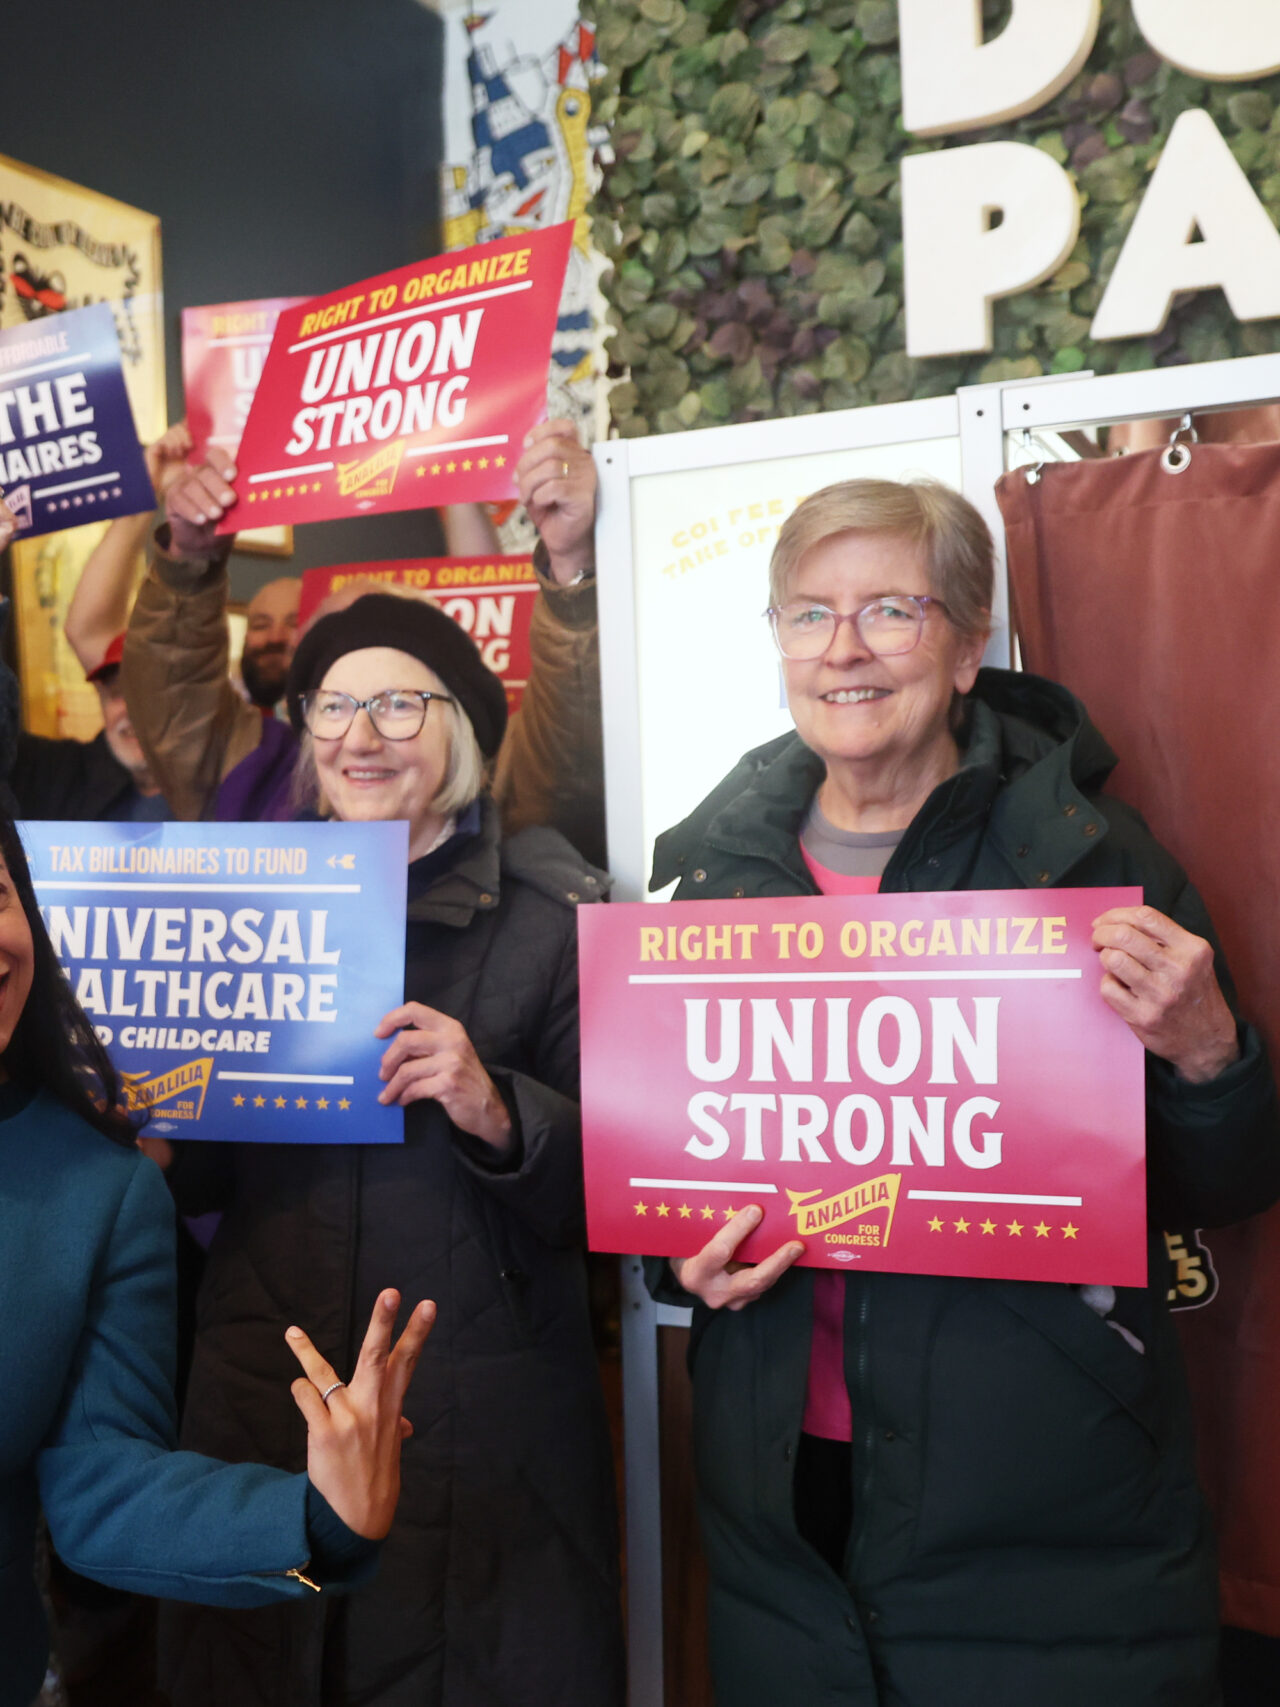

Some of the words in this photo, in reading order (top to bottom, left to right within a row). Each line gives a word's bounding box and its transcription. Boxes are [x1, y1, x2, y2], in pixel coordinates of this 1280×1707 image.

[298, 295, 365, 338] RIGHT
[368, 285, 398, 314] TO
[402, 248, 532, 304] ORGANIZE
[299, 307, 485, 404] UNION
[284, 375, 470, 456] STRONG
[403, 568, 431, 587] TO
[48, 845, 85, 873] TAX
[88, 846, 220, 875] BILLIONAIRES
[224, 847, 248, 875] TO
[253, 847, 308, 876] FUND
[38, 905, 342, 966] NIVERSAL
[639, 924, 759, 961] RIGHT
[771, 921, 824, 960] TO
[840, 916, 1069, 959] ORGANIZE
[60, 967, 339, 1023] ALTHCARE
[119, 1026, 272, 1054] CHILDCARE
[683, 995, 1003, 1086] UNION
[135, 1064, 204, 1104] ANALILIA
[176, 1100, 195, 1110] FOR
[683, 1091, 1005, 1170] STRONG
[805, 1181, 891, 1230] ANALILIA
[824, 1233, 881, 1247] CONGRESS
[858, 1224, 881, 1236] FOR
